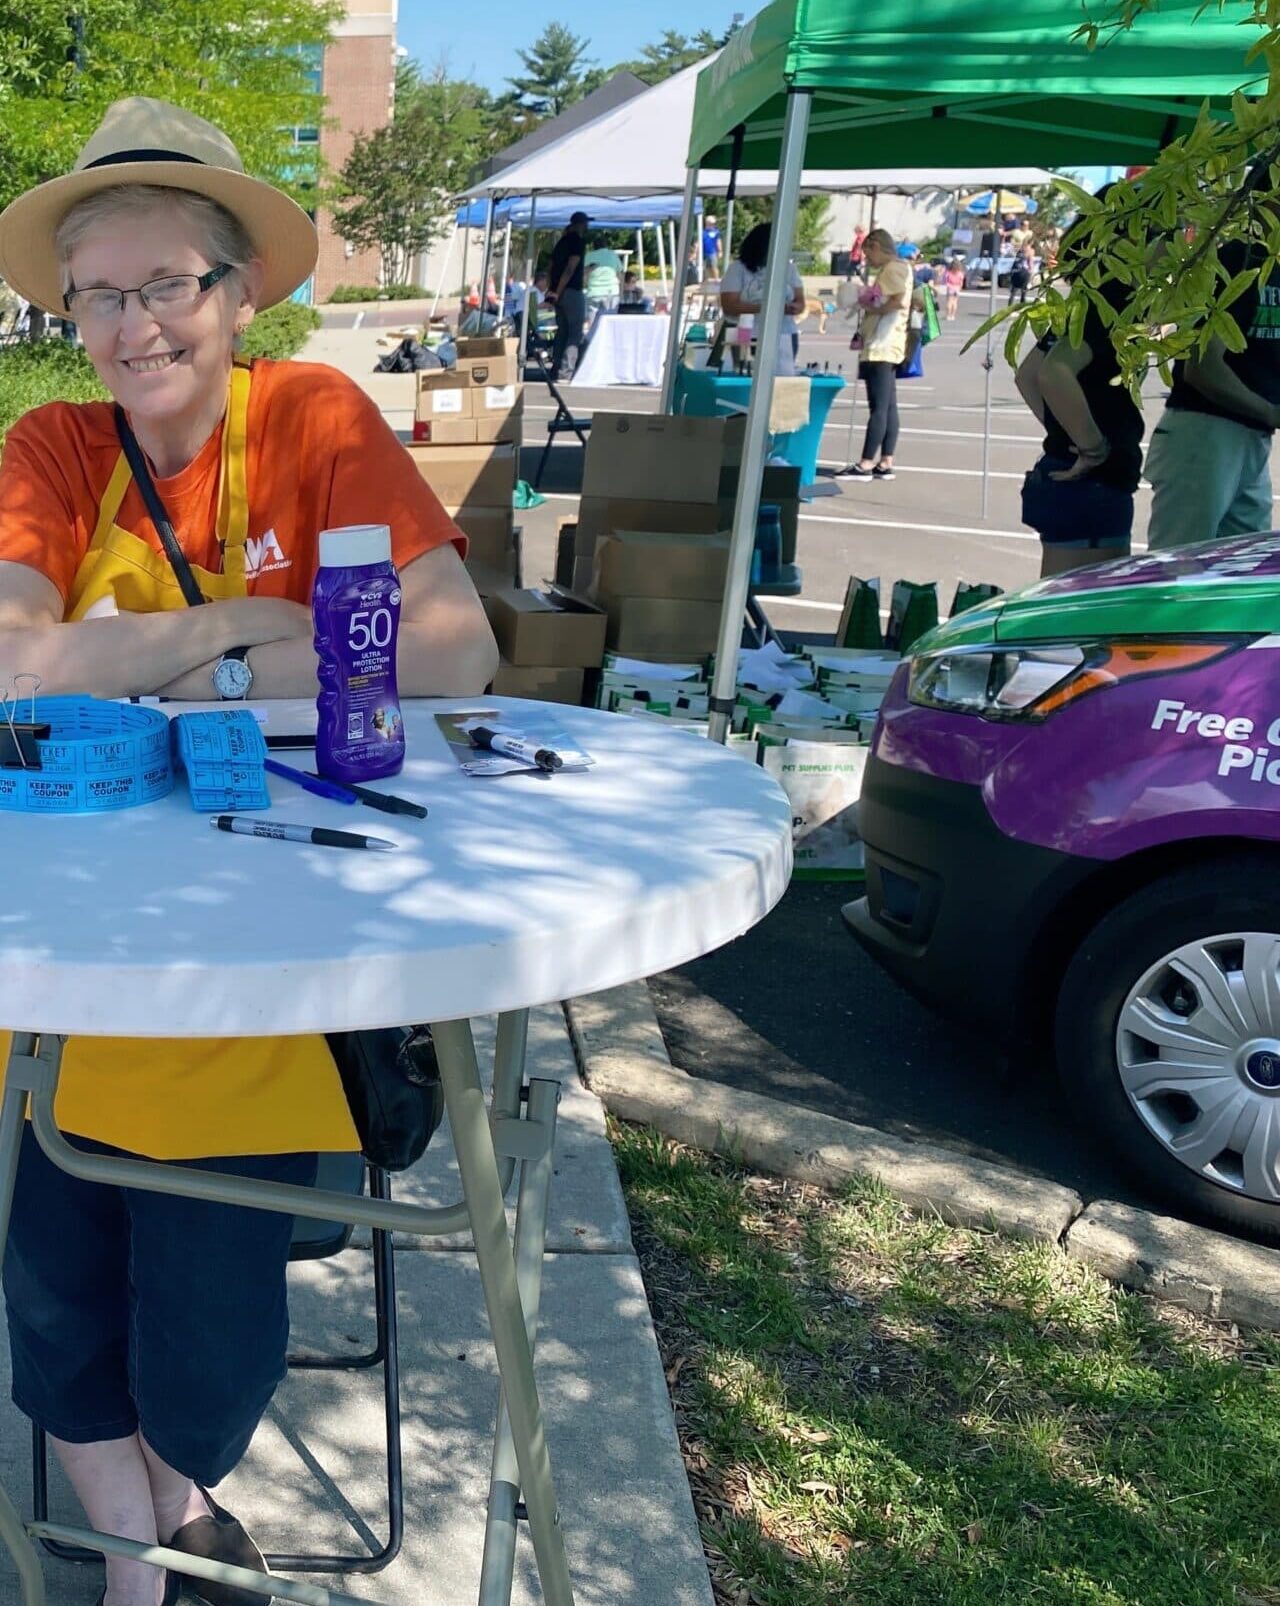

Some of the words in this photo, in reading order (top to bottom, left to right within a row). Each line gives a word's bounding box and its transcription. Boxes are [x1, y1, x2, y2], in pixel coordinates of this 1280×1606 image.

[360, 599, 382, 609] Health
[348, 608, 392, 651] 50
[361, 650, 381, 659] ULTRA
[353, 656, 390, 668] PROTECTION
[360, 665, 383, 674] LOTION
[1151, 699, 1254, 741] Free
[41, 747, 67, 757] CKET
[93, 742, 128, 756] TICKET
[782, 764, 796, 772] PET
[799, 764, 833, 773] SUPPLIES
[834, 763, 855, 772] PLUS
[0, 780, 17, 788] THIS
[29, 782, 52, 791] KEEP
[54, 783, 74, 791] THIS
[90, 781, 113, 791] KEEP
[115, 777, 133, 787] THIS
[33, 789, 70, 798] COUPON
[94, 786, 130, 797] COUPON
